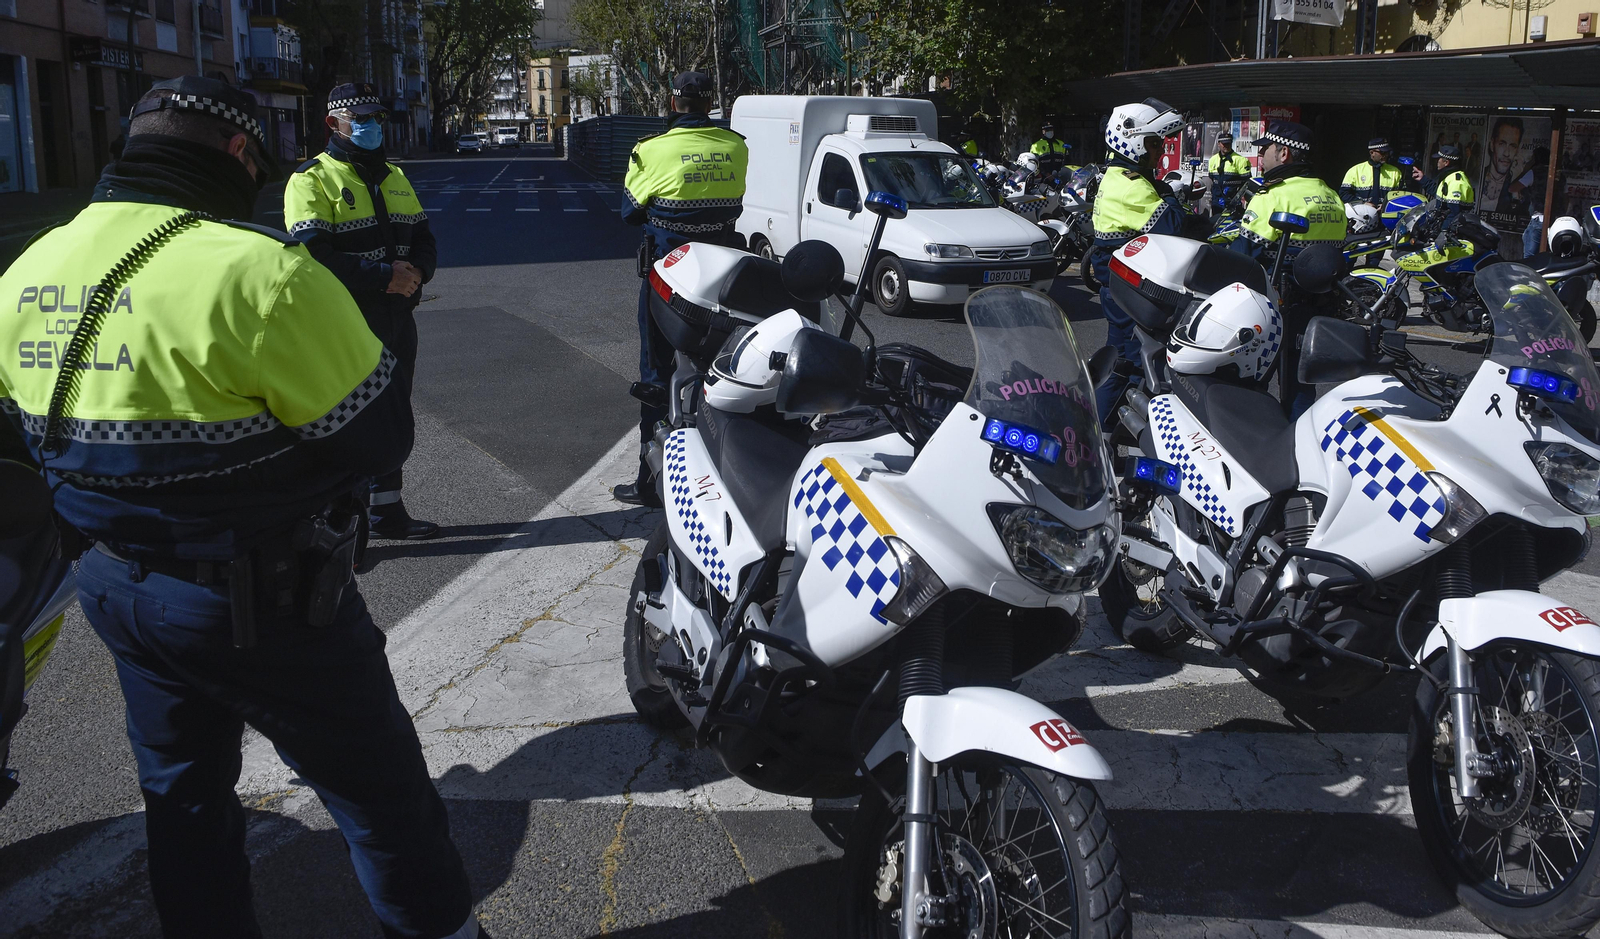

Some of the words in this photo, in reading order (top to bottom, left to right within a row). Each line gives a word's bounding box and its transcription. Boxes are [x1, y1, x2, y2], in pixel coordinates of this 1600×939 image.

[1323, 1, 1334, 10] 04
[101, 45, 139, 68] PISTER
[1433, 116, 1451, 125] ECOS
[1460, 116, 1485, 127] ROCIO
[681, 152, 733, 164] POLICIA
[696, 163, 722, 171] LOCAL
[683, 171, 736, 183] SEVILLA
[1308, 212, 1344, 224] SEVILLA
[1490, 212, 1517, 223] SEVILLA
[990, 271, 1012, 282] 0870
[1013, 271, 1028, 281] CVL
[45, 319, 100, 335] LOC
[1521, 337, 1576, 360] POLICIA
[18, 341, 135, 372] SEVLA
[999, 378, 1070, 401] POLICIA
[1174, 372, 1200, 403] HONDA
[701, 401, 718, 440] HONDA
